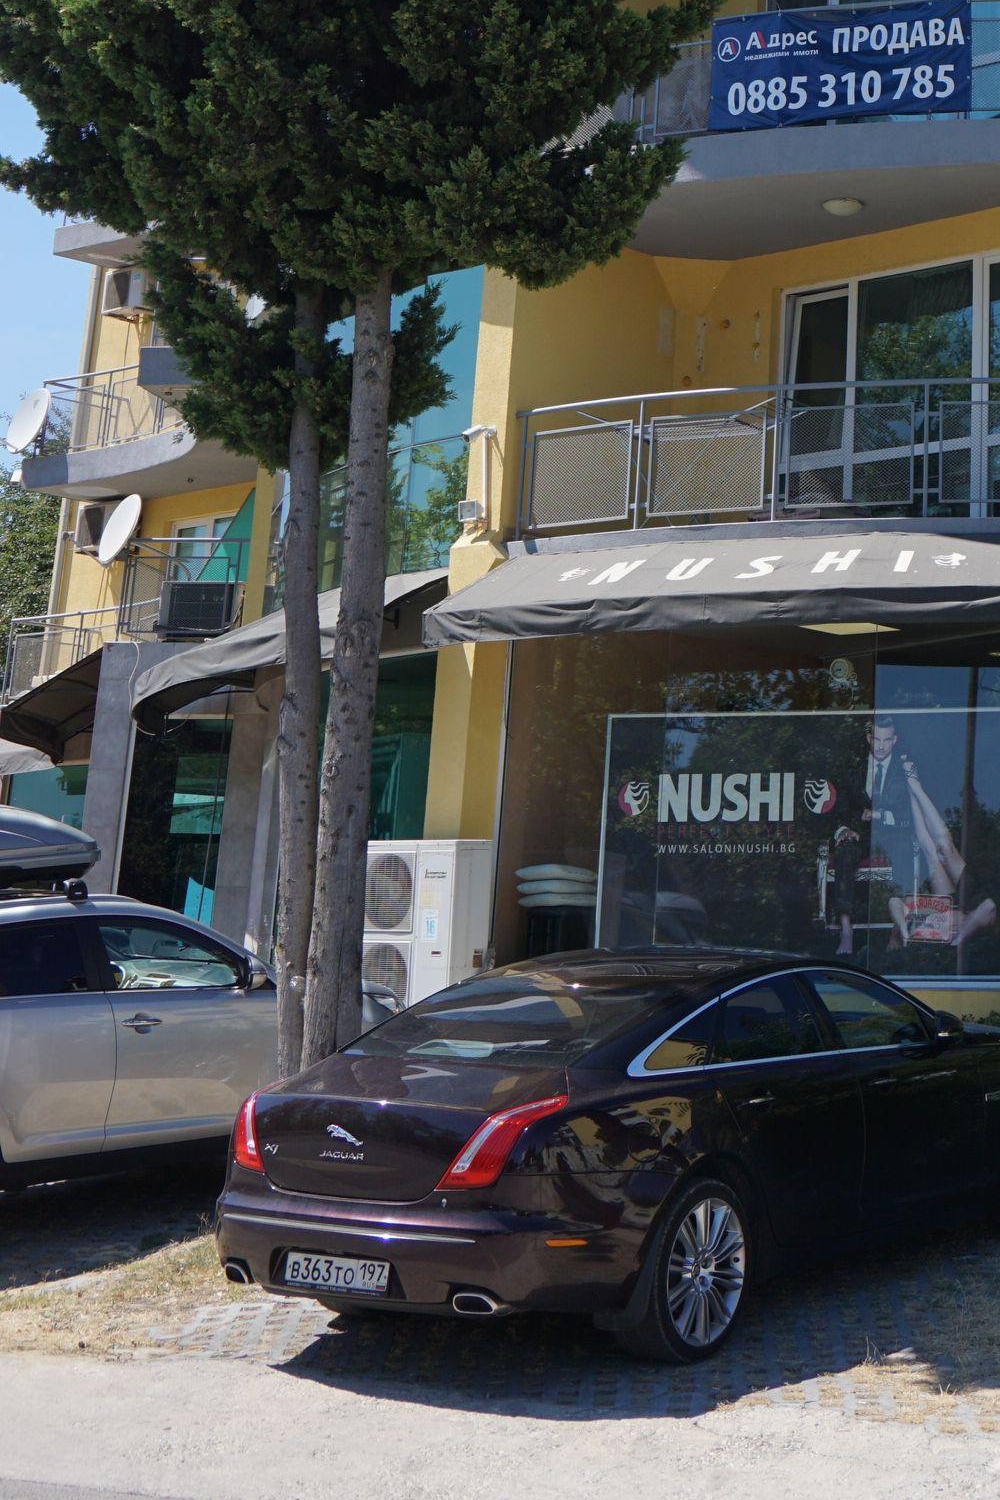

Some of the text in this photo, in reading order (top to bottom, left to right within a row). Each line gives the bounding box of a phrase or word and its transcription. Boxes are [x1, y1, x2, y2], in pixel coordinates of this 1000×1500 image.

[745, 30, 818, 51] Адрес
[832, 17, 965, 56] ПРОДАВА
[744, 51, 790, 61] недвижими
[727, 64, 955, 116] 0885 310 785
[587, 549, 915, 586] NUSHI
[657, 772, 795, 823] NUSHI
[657, 843, 796, 854] WWW.SALONINUSHI.BG
[319, 1150, 364, 1160] JAGUAR
[360, 1263, 386, 1282] 197
